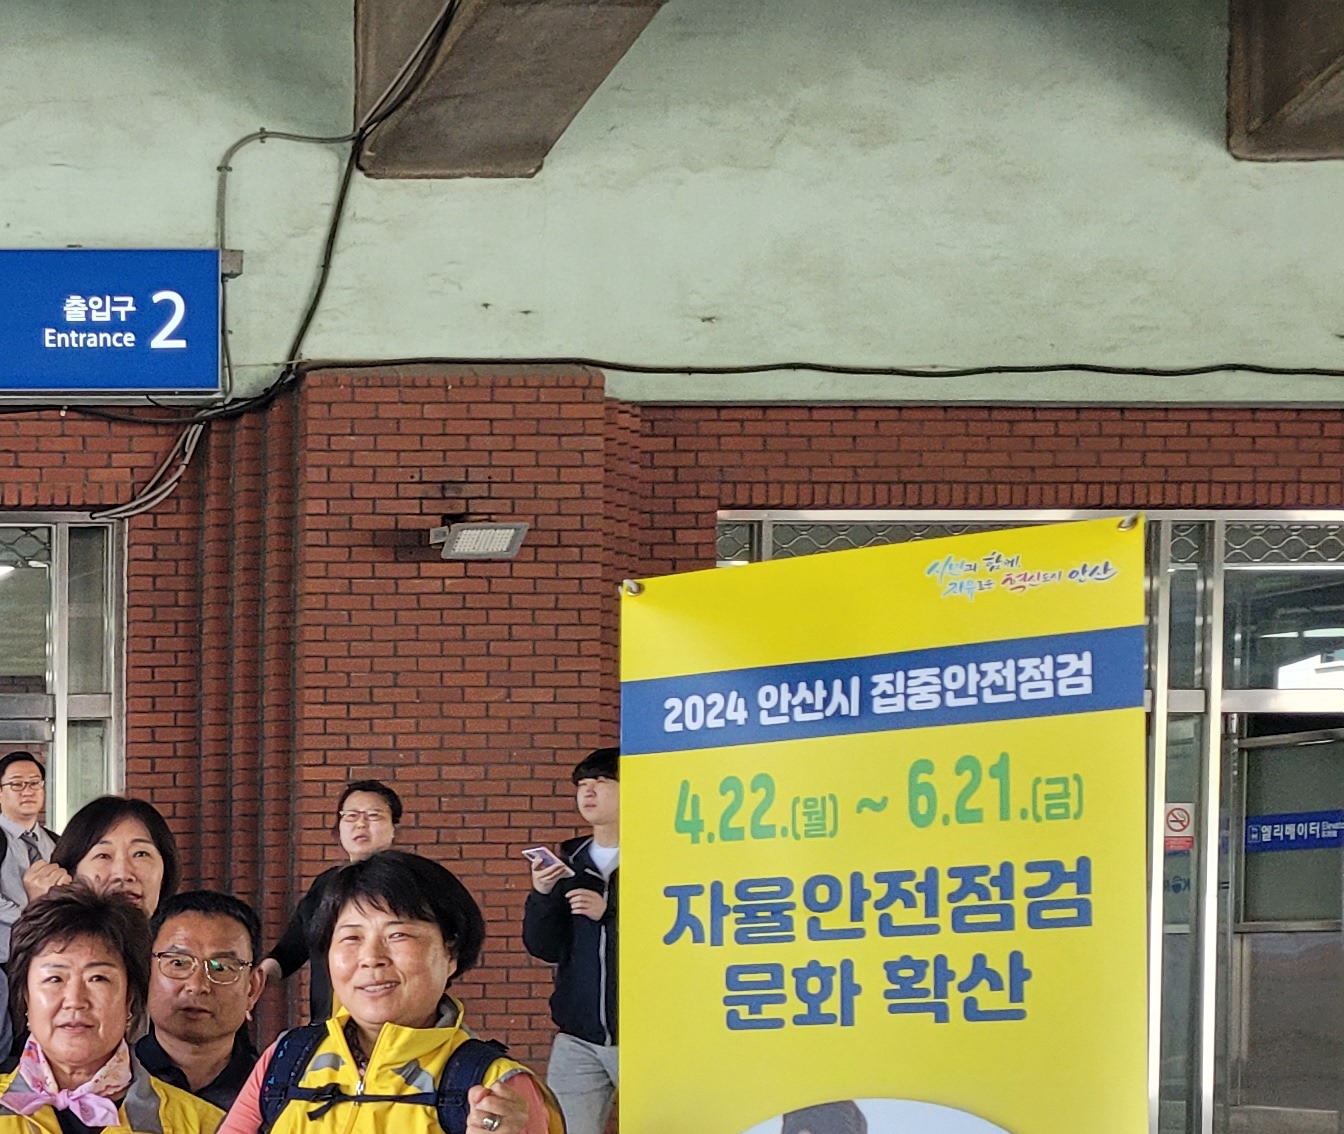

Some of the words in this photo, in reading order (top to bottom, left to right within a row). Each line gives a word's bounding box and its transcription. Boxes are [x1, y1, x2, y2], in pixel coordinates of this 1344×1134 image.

[63, 294, 137, 322] 출입구
[150, 290, 187, 349] 2
[44, 328, 136, 348] Entrance
[1001, 571, 1063, 592] 혁신도시
[1068, 560, 1118, 583] 안산
[663, 690, 749, 733] 2024
[758, 676, 860, 726] 안산시
[871, 650, 1093, 715] 집중안전점검
[674, 773, 838, 844] 4.22.(월)
[907, 752, 1084, 829] 6.21.(금)
[1261, 821, 1321, 842] 엘리베이터
[662, 855, 1093, 947] 자율안전점검
[722, 958, 863, 1031] 문화
[883, 950, 1033, 1024] 확산
